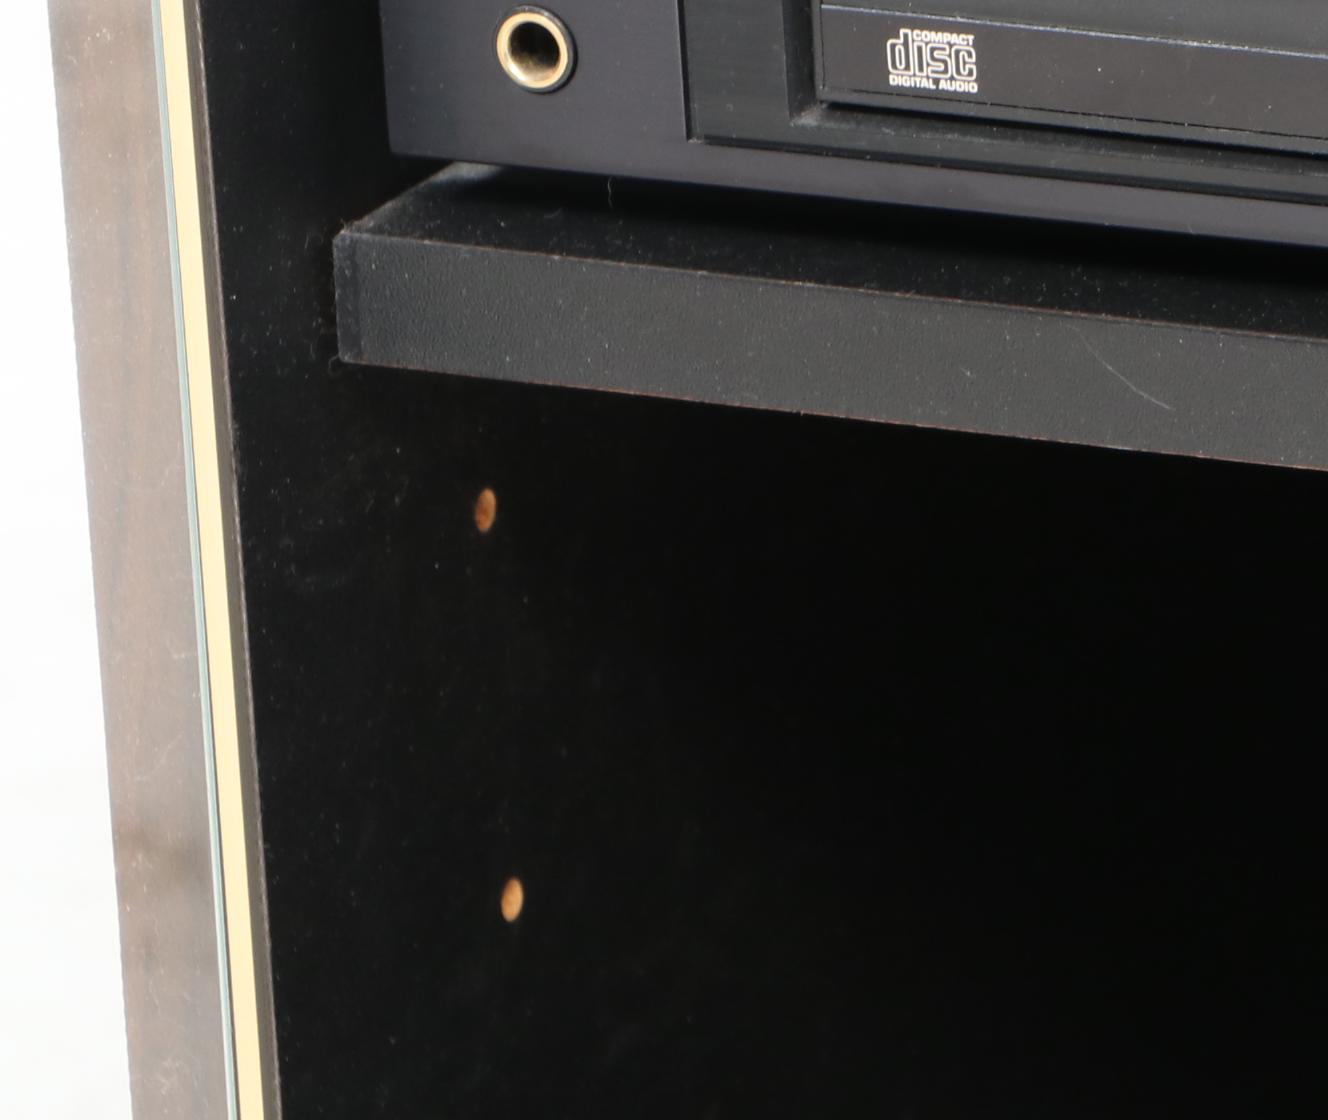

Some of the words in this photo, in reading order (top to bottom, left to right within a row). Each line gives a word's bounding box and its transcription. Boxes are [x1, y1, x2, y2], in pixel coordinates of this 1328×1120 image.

[912, 30, 975, 47] COMPACT
[889, 74, 937, 89] DIGITAL
[938, 78, 978, 93] AUDIO
